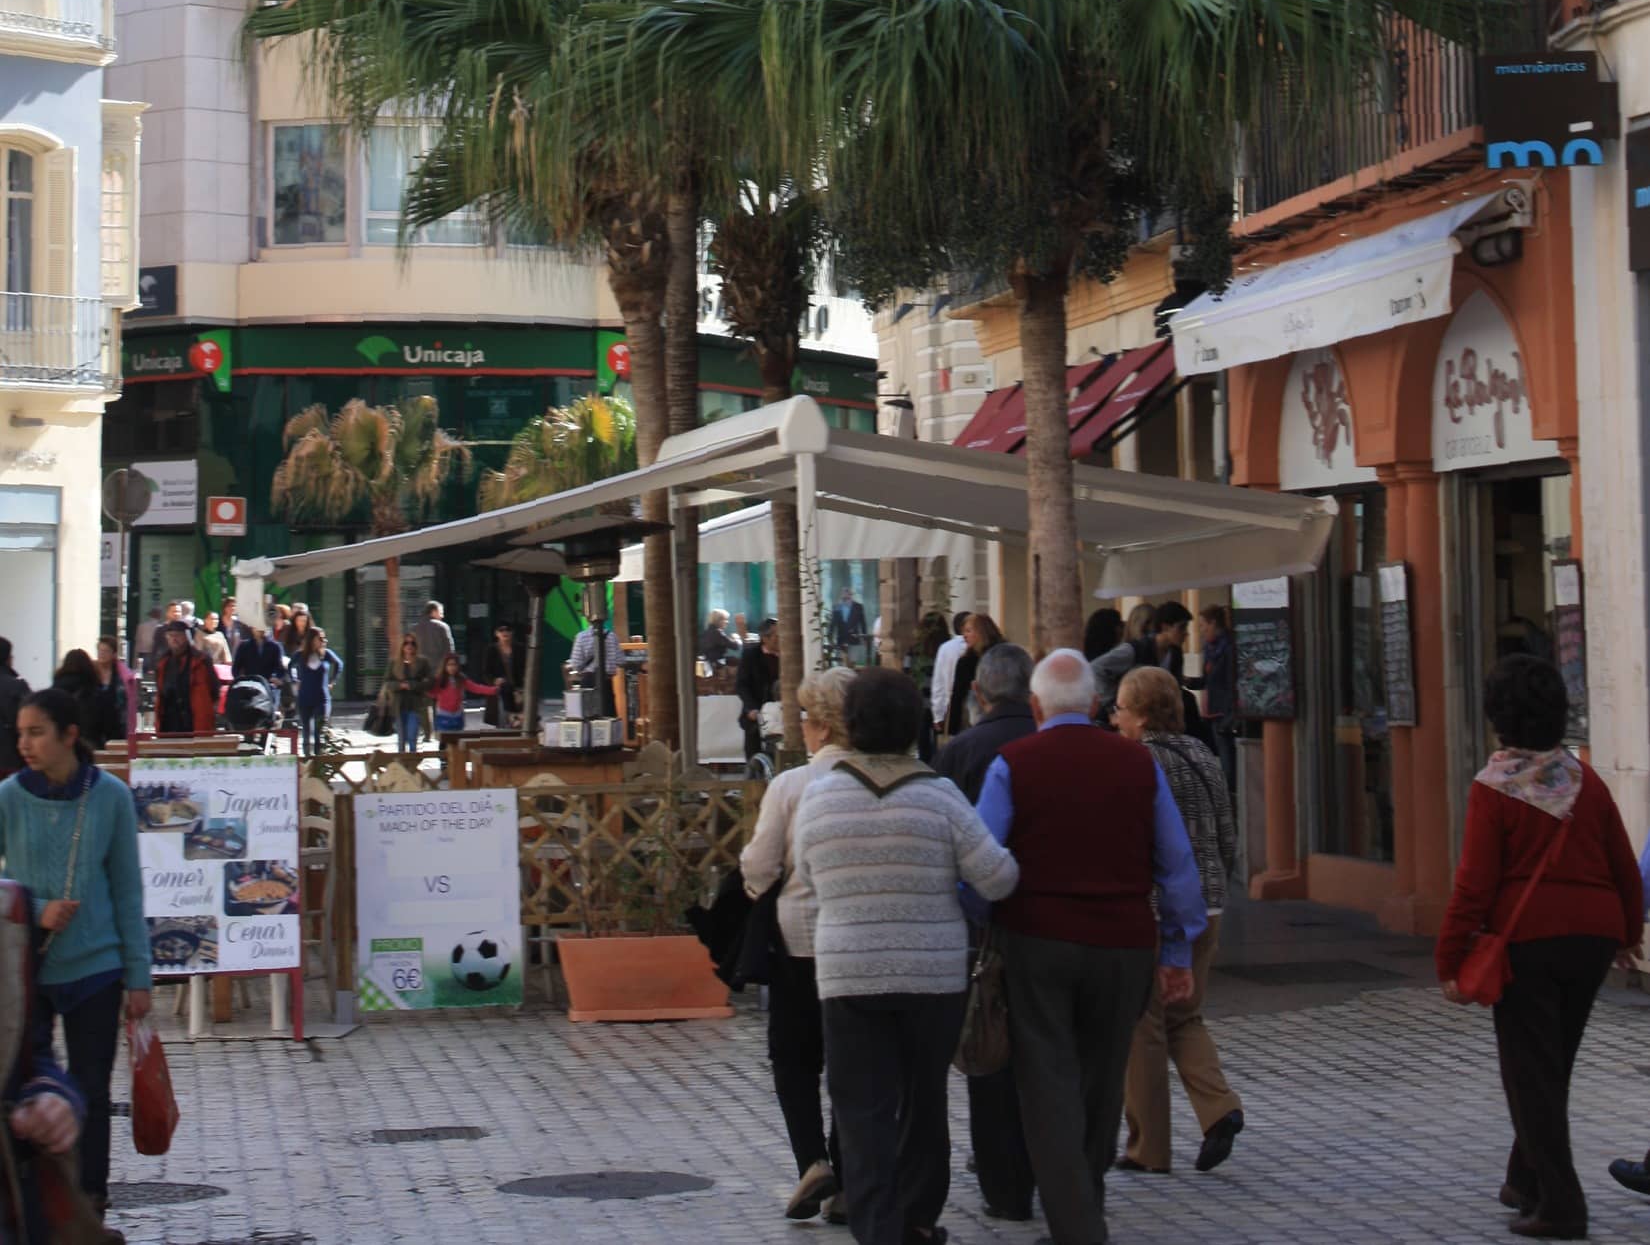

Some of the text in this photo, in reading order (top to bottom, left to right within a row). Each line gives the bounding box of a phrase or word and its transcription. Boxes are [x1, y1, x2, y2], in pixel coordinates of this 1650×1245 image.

[132, 347, 183, 373] Unicaja
[403, 341, 484, 368] Unicaja
[216, 788, 289, 818] Tapear
[378, 803, 437, 817] PARTIDO
[440, 802, 468, 815] DEL
[379, 817, 494, 833] MACH OF THE DAY
[424, 875, 451, 893] VS
[225, 922, 285, 944] Cenar
[392, 968, 421, 990] 6€
